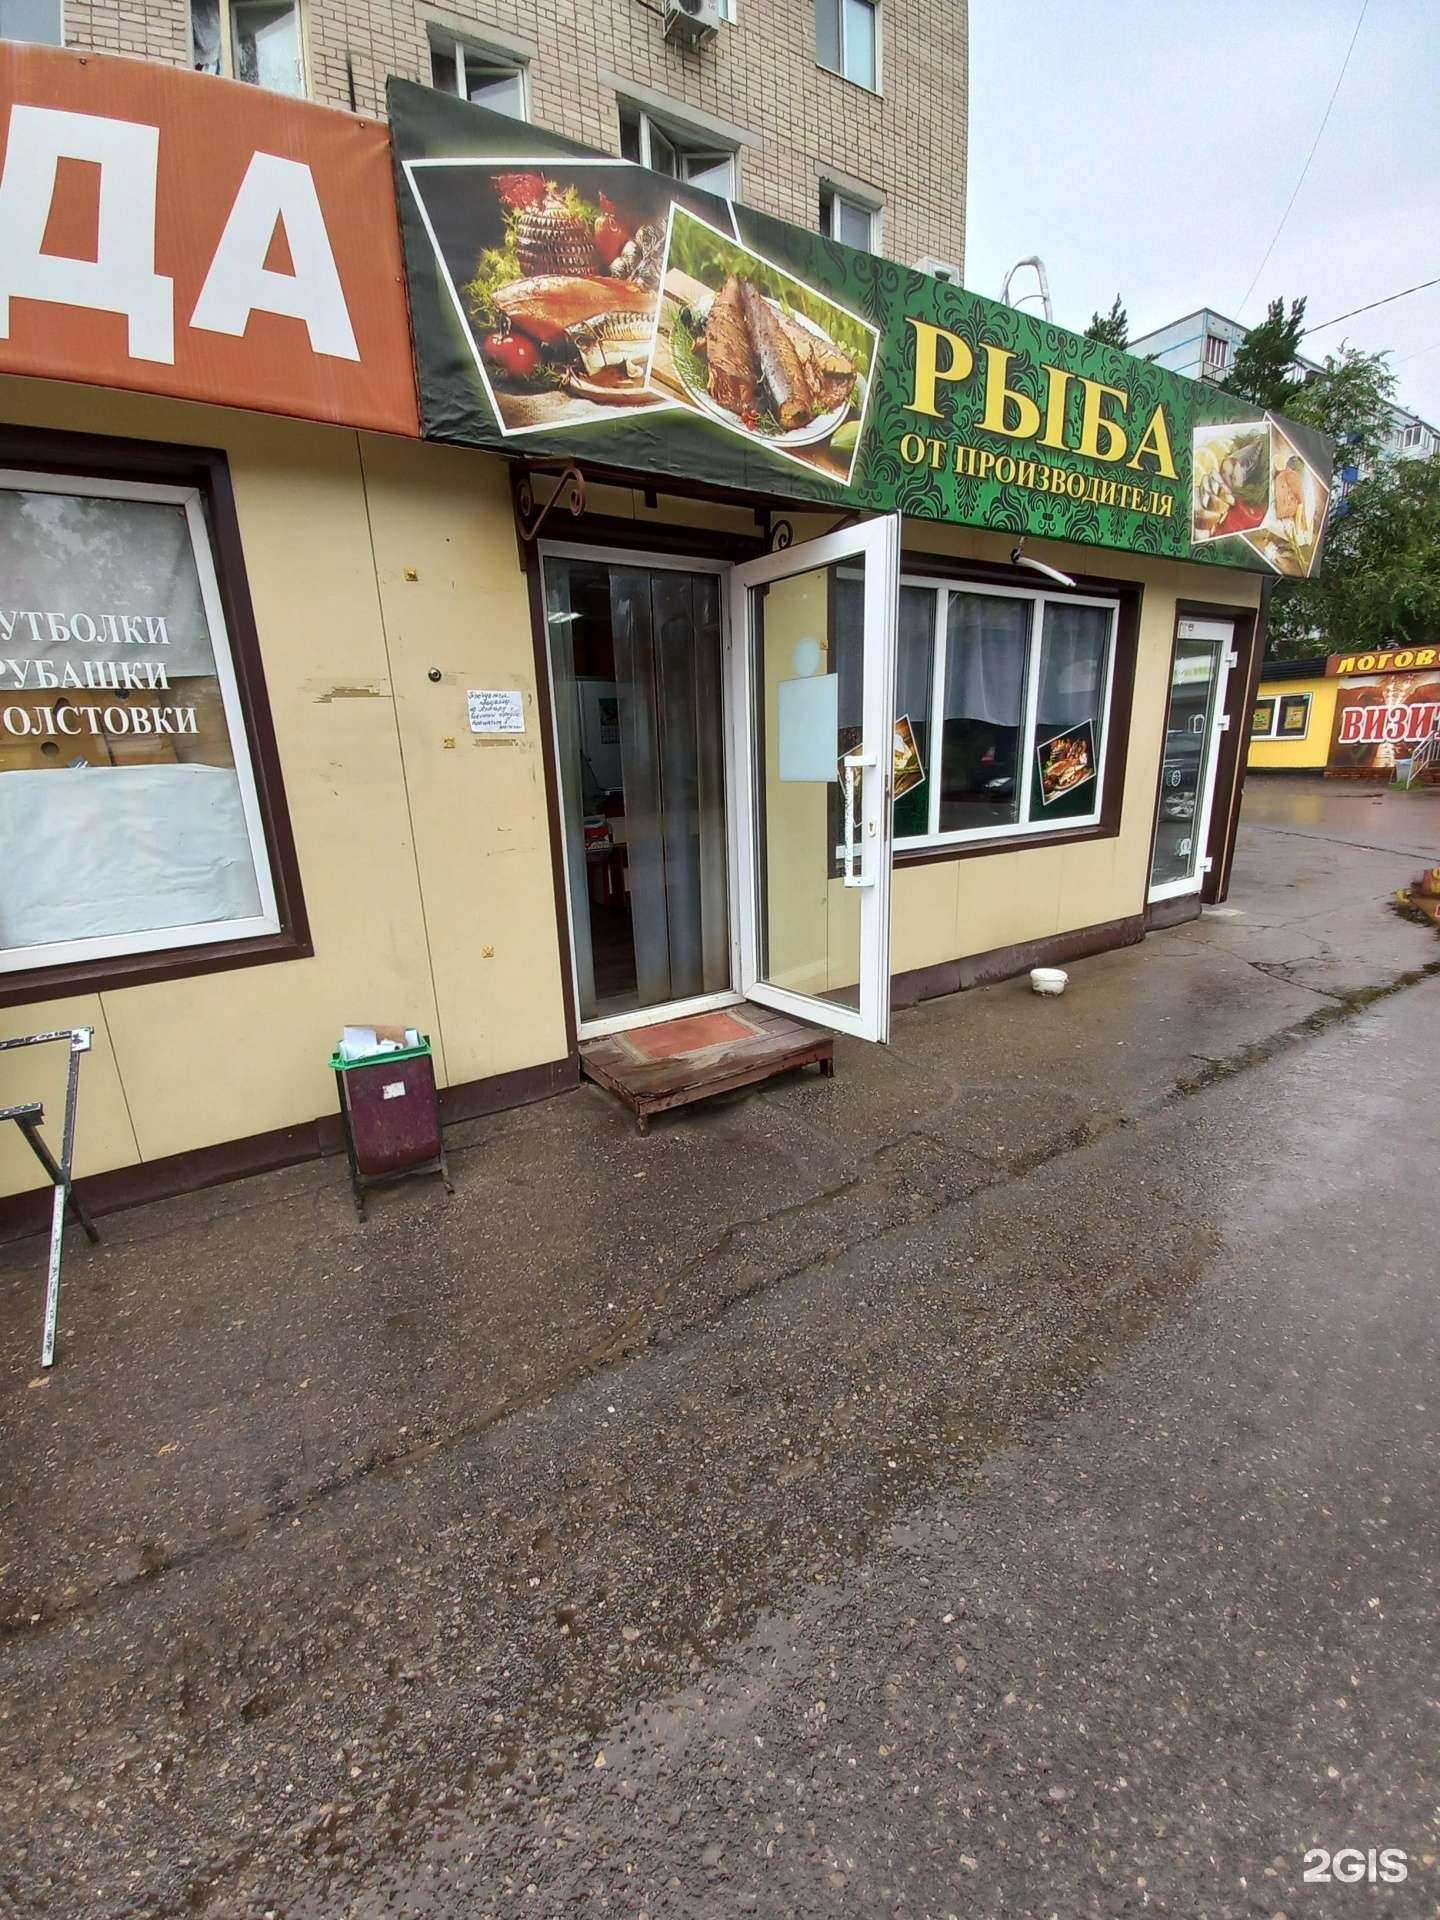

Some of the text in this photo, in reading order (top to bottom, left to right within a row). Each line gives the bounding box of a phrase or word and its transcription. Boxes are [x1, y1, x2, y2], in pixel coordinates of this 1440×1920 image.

[0, 104, 361, 365] ДА
[903, 316, 1180, 481] РЫБА
[900, 433, 1174, 517] ОТ ПРОИЗВОДИТЕЛЯ
[1336, 649, 1440, 674] ЛОГОВ
[1338, 703, 1440, 743] ВИЗИ
